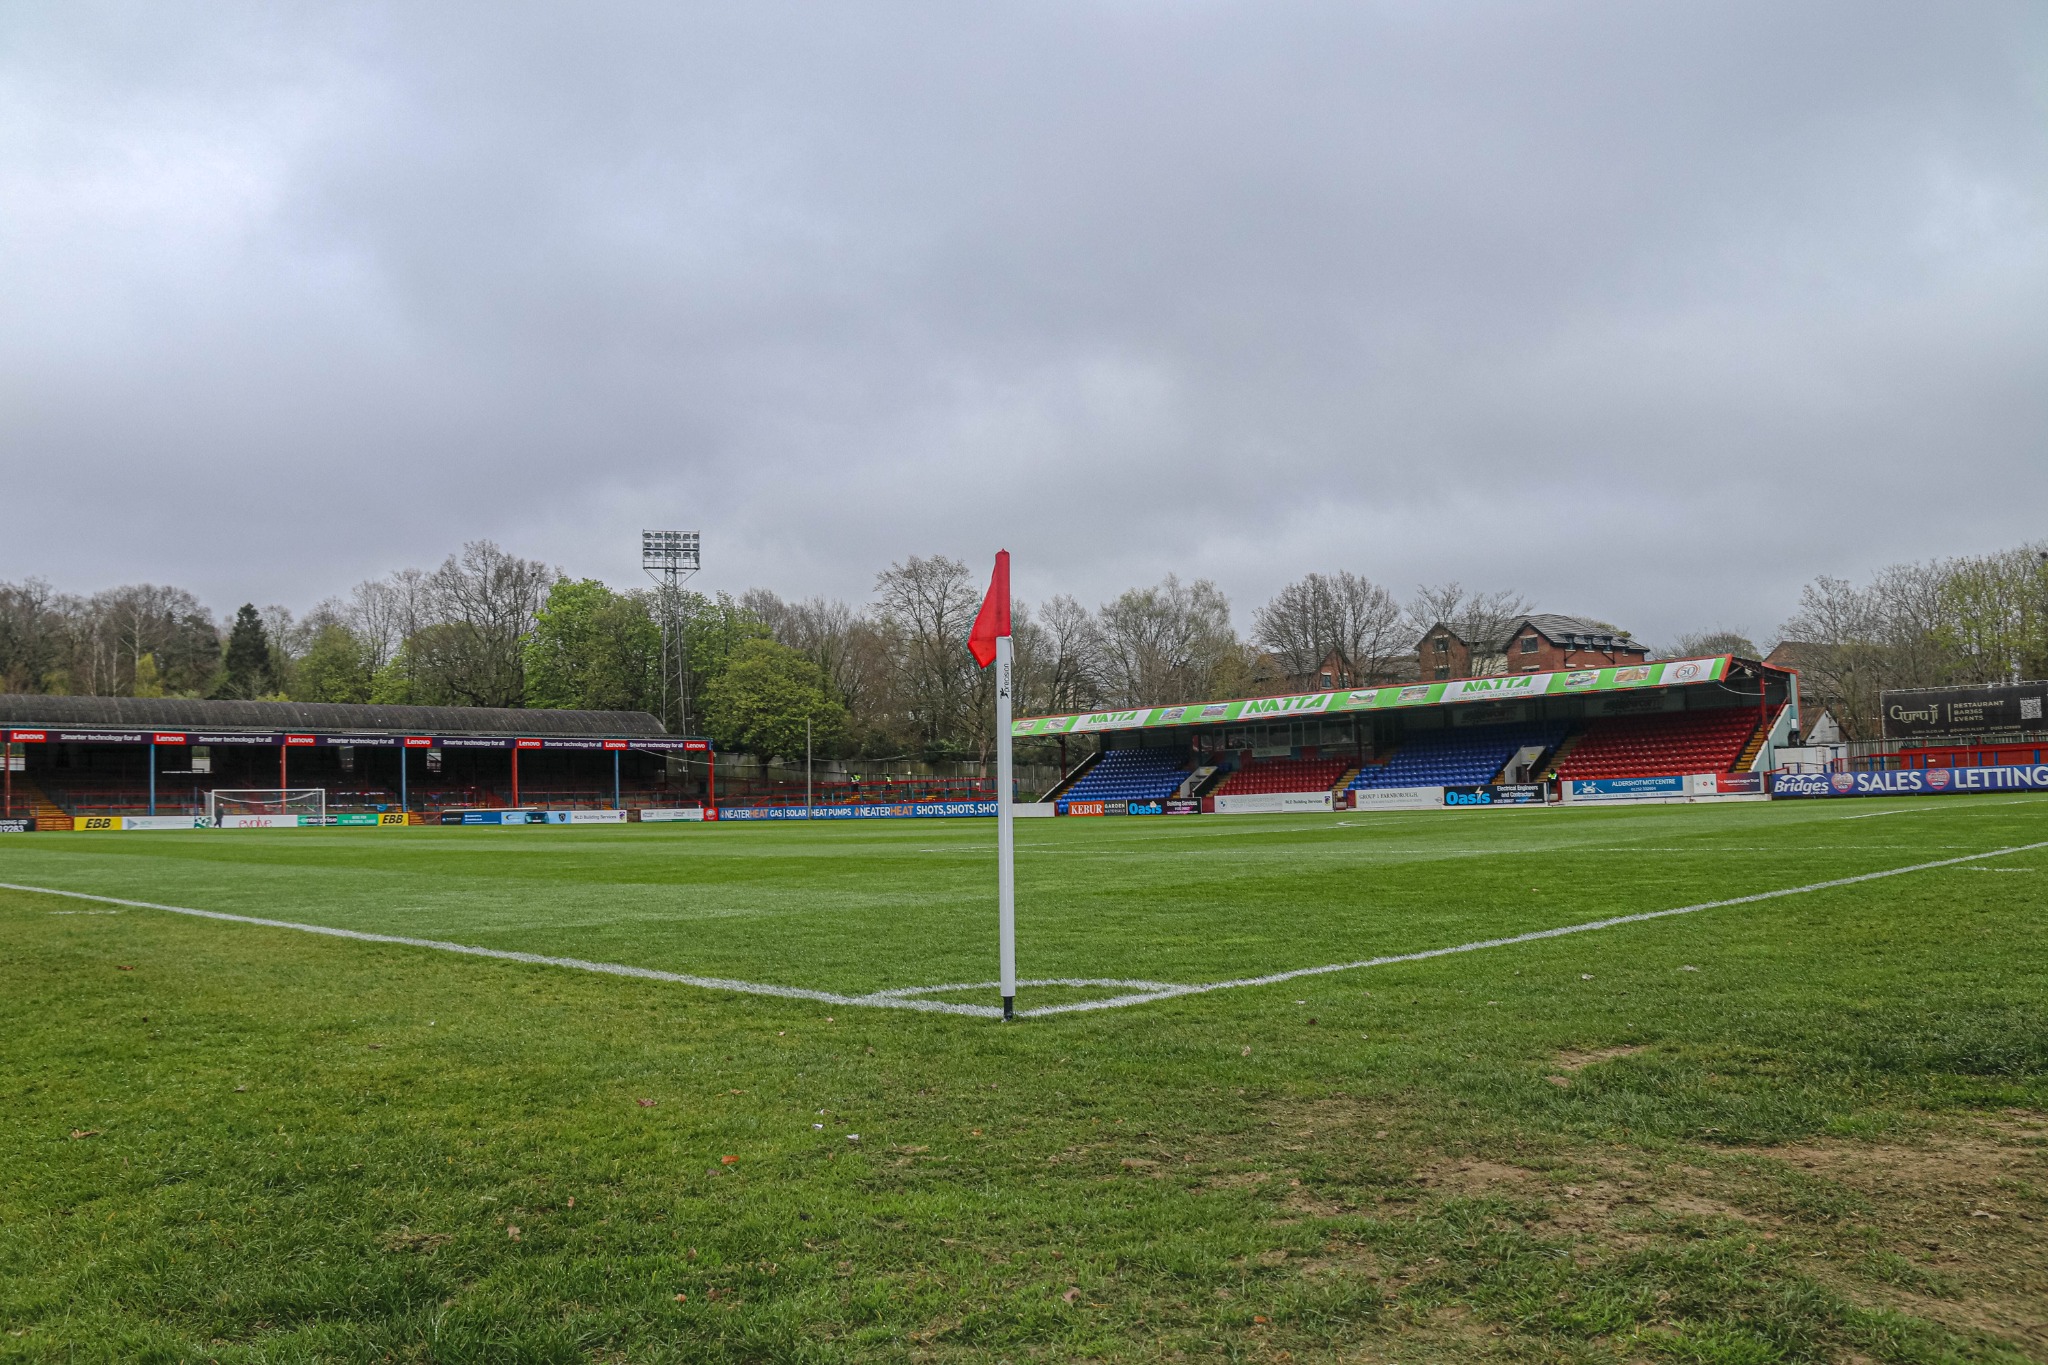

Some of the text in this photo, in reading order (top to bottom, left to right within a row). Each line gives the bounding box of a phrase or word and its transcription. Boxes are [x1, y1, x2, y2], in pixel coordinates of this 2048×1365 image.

[1462, 675, 1533, 692] NATTA
[1246, 694, 1328, 714] NATTA
[1953, 700, 2005, 709] RESTAURANT
[1088, 711, 1138, 724] NATTA
[1857, 772, 1922, 792] SALES
[1954, 766, 2048, 788] LETTING
[1774, 780, 1830, 794] Bridges
[1446, 792, 1491, 805] Oasis
[725, 808, 852, 818] NEATERHEAT GAS SOLAR HEAT PUMPS
[860, 806, 914, 816] NEATERHEAT
[978, 803, 998, 814] SHO
[1071, 804, 1103, 815] KEBUR
[1129, 803, 1162, 815] Oasis
[86, 818, 111, 828] EBB
[239, 816, 272, 828] evolve
[382, 814, 404, 824] EBB
